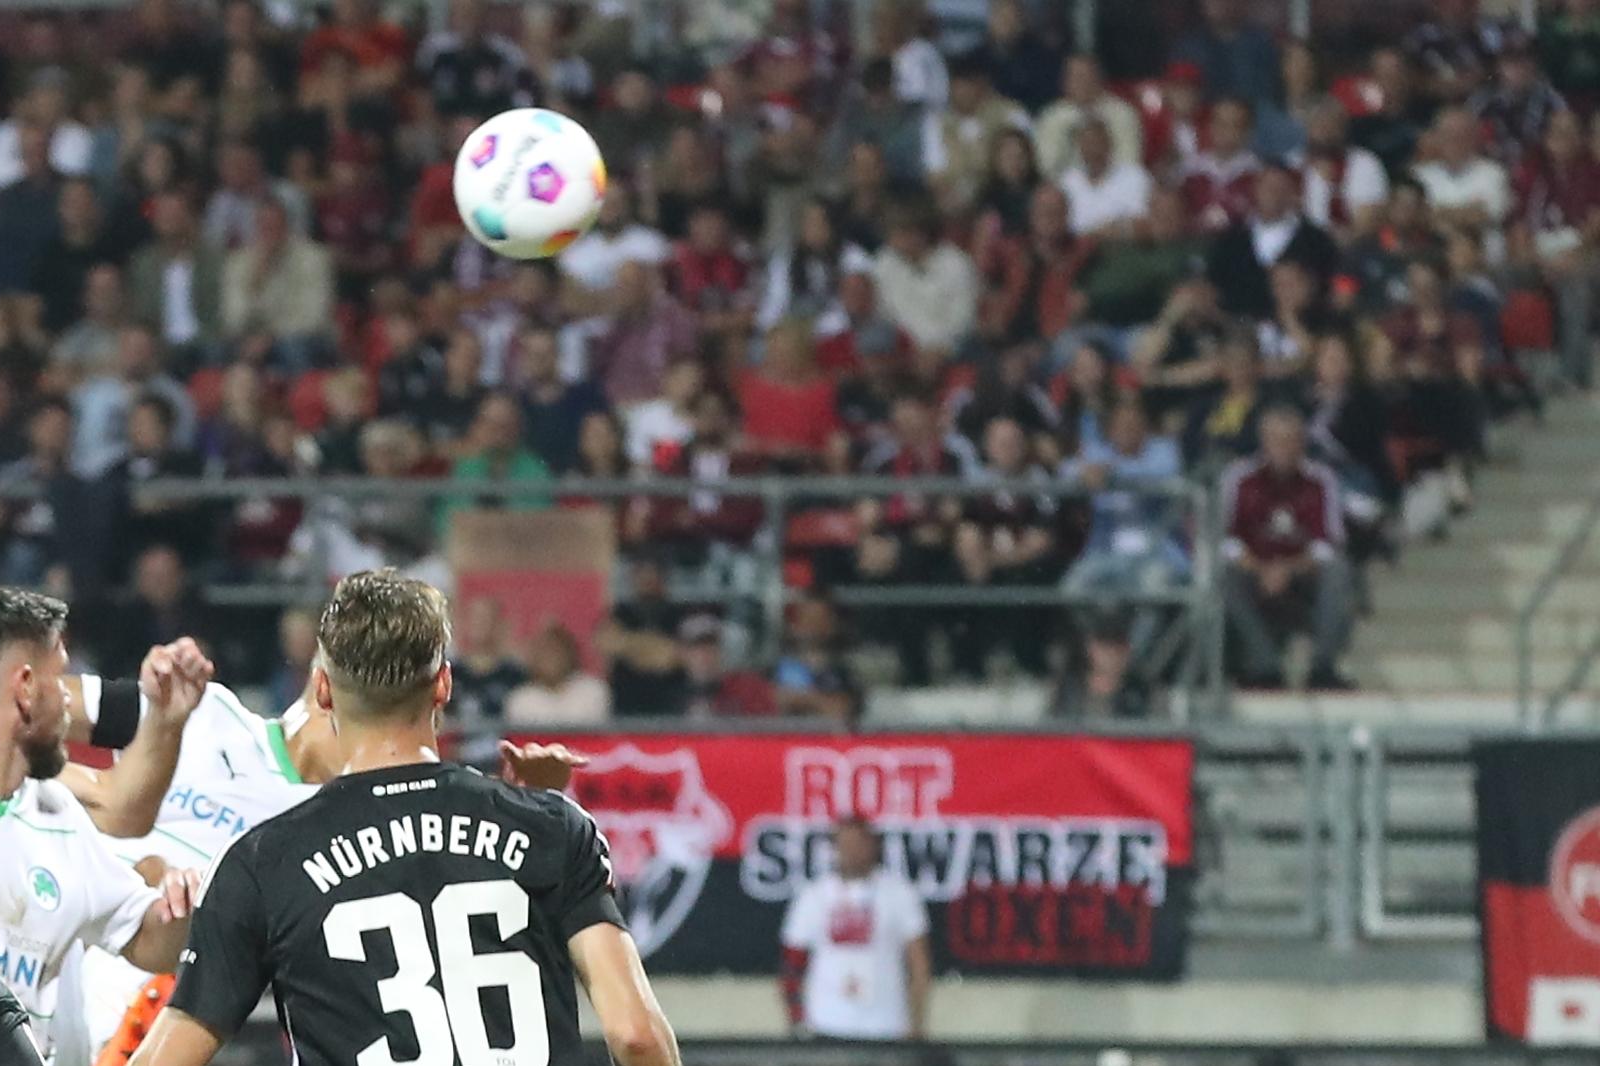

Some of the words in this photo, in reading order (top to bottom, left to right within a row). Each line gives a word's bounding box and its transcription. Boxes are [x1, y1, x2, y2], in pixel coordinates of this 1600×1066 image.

[790, 750, 948, 822] ROT
[302, 813, 531, 894] NÜRNBERG
[750, 822, 1160, 892] SCWARZE
